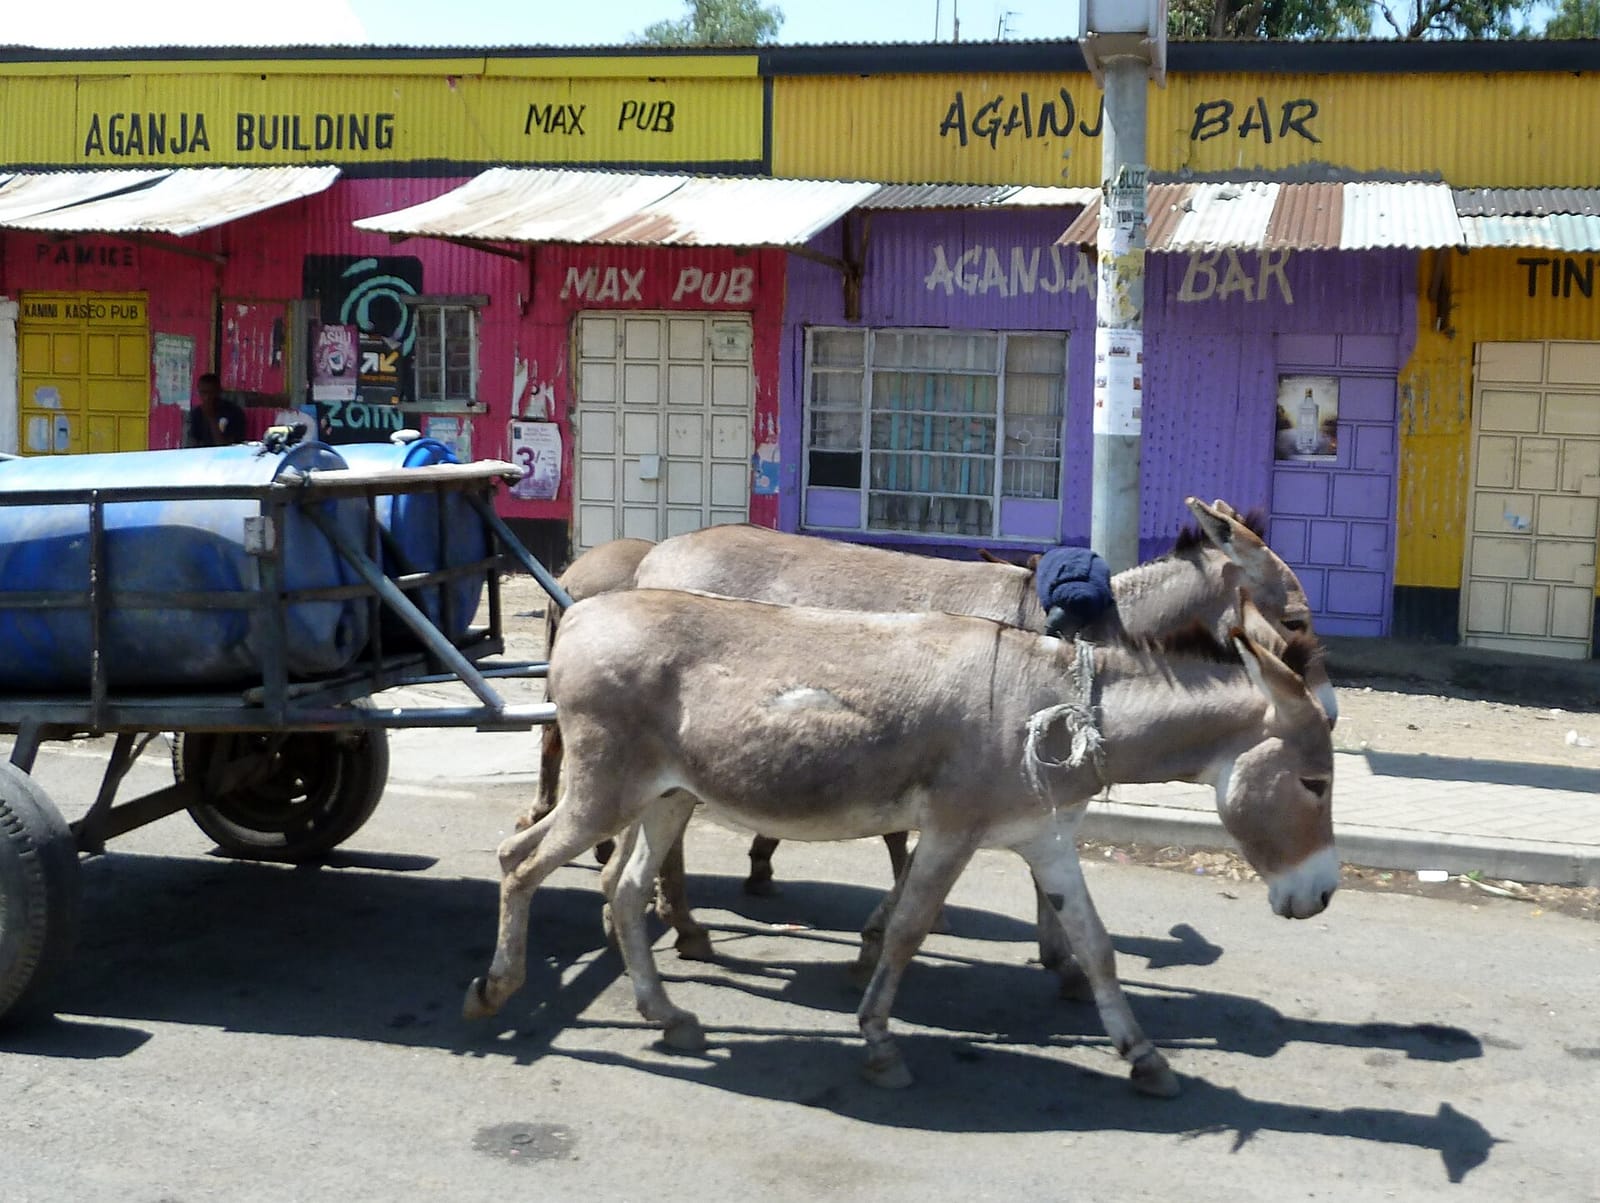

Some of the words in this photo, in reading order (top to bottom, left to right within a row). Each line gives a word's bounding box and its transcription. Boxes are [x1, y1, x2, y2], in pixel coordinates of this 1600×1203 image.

[85, 113, 210, 156] AGANJA
[236, 113, 395, 151] BUILDING
[524, 103, 586, 135] MAX
[617, 100, 675, 132] PUB
[940, 87, 1104, 150] AGANJ
[1190, 97, 1322, 143] BAR
[560, 266, 645, 301] MAX
[672, 267, 754, 304] PUB
[924, 244, 1097, 301] AGANJA
[1176, 243, 1294, 305] BAR
[1516, 257, 1600, 298] TIN
[110, 305, 138, 319] PUB
